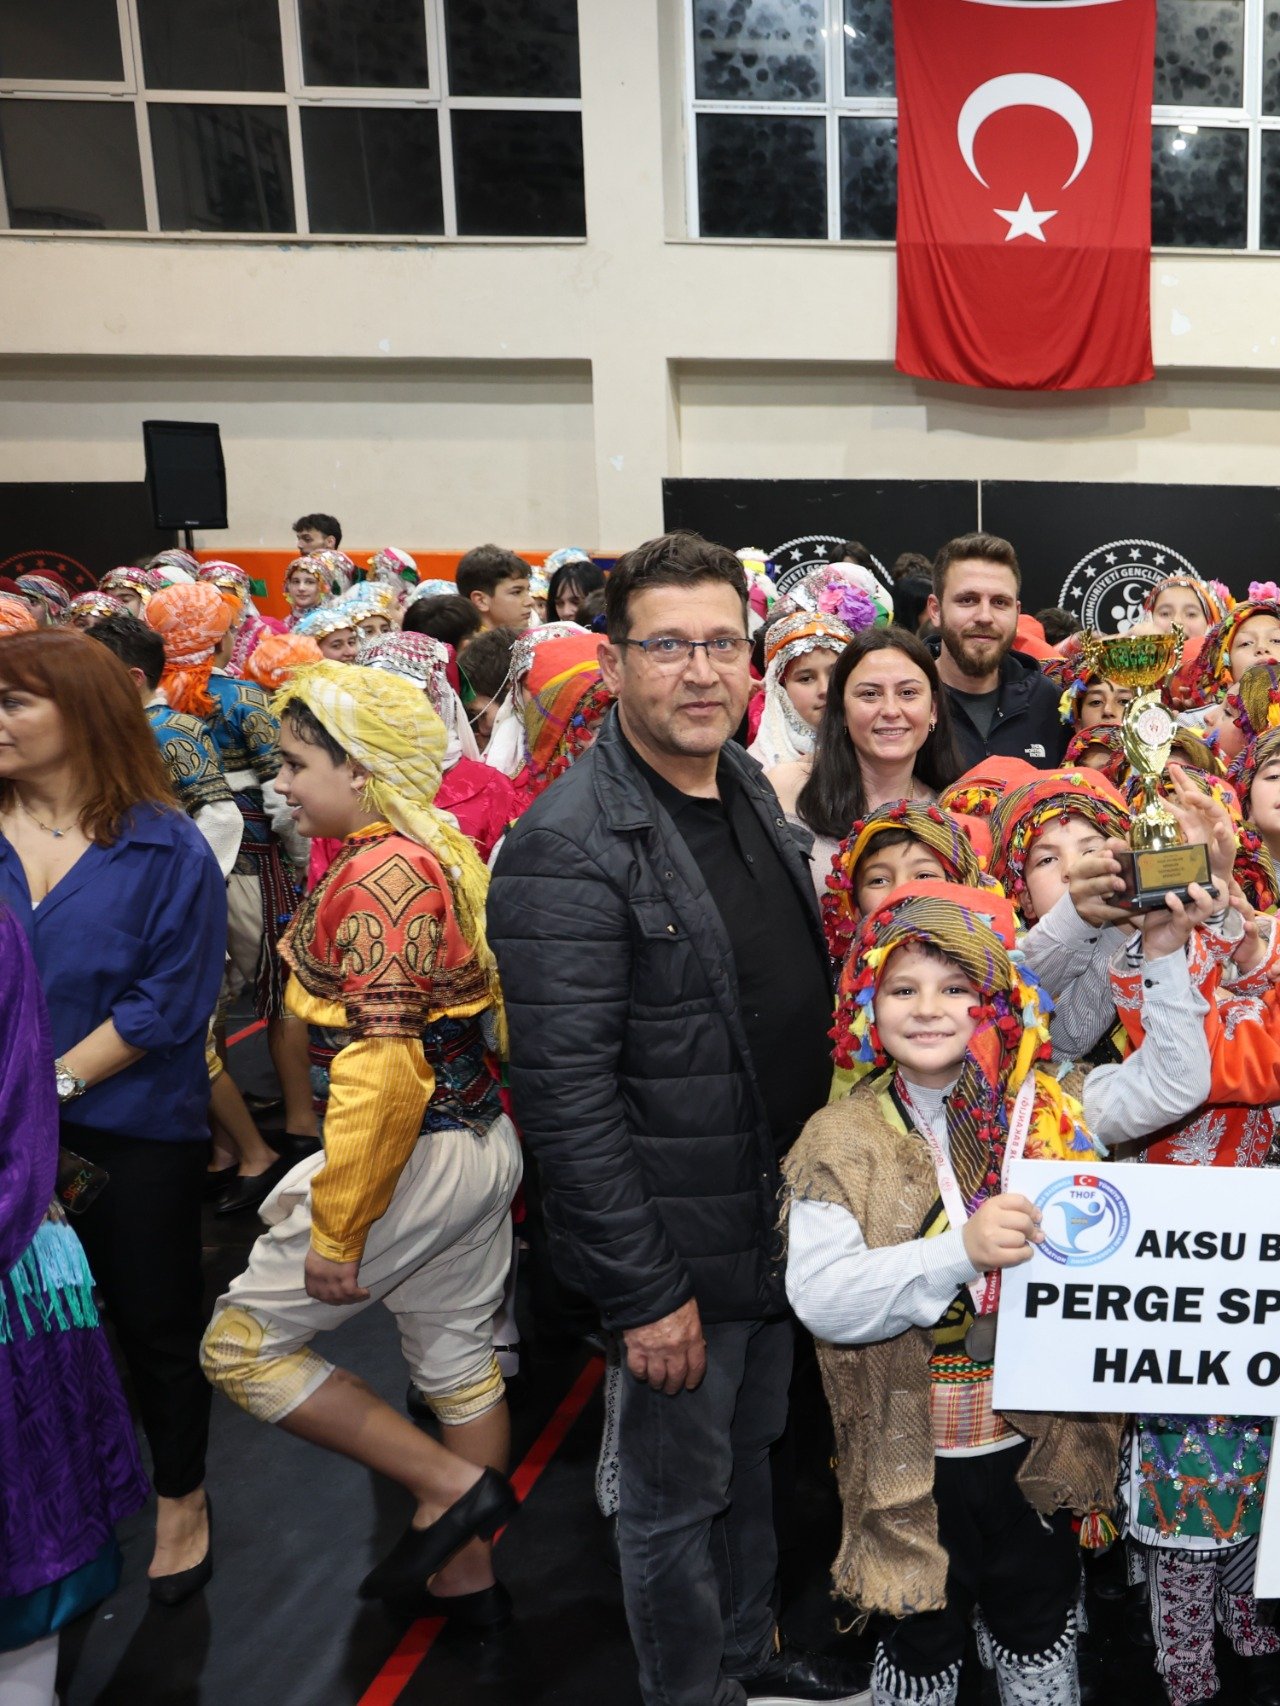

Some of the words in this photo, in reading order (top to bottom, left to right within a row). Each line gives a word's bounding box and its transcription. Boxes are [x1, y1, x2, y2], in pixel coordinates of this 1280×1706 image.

[1070, 1190, 1096, 1200] THOF
[1136, 1230, 1246, 1260] AKSU
[1025, 1282, 1205, 1323] PERGE
[1092, 1347, 1231, 1386] HALK
